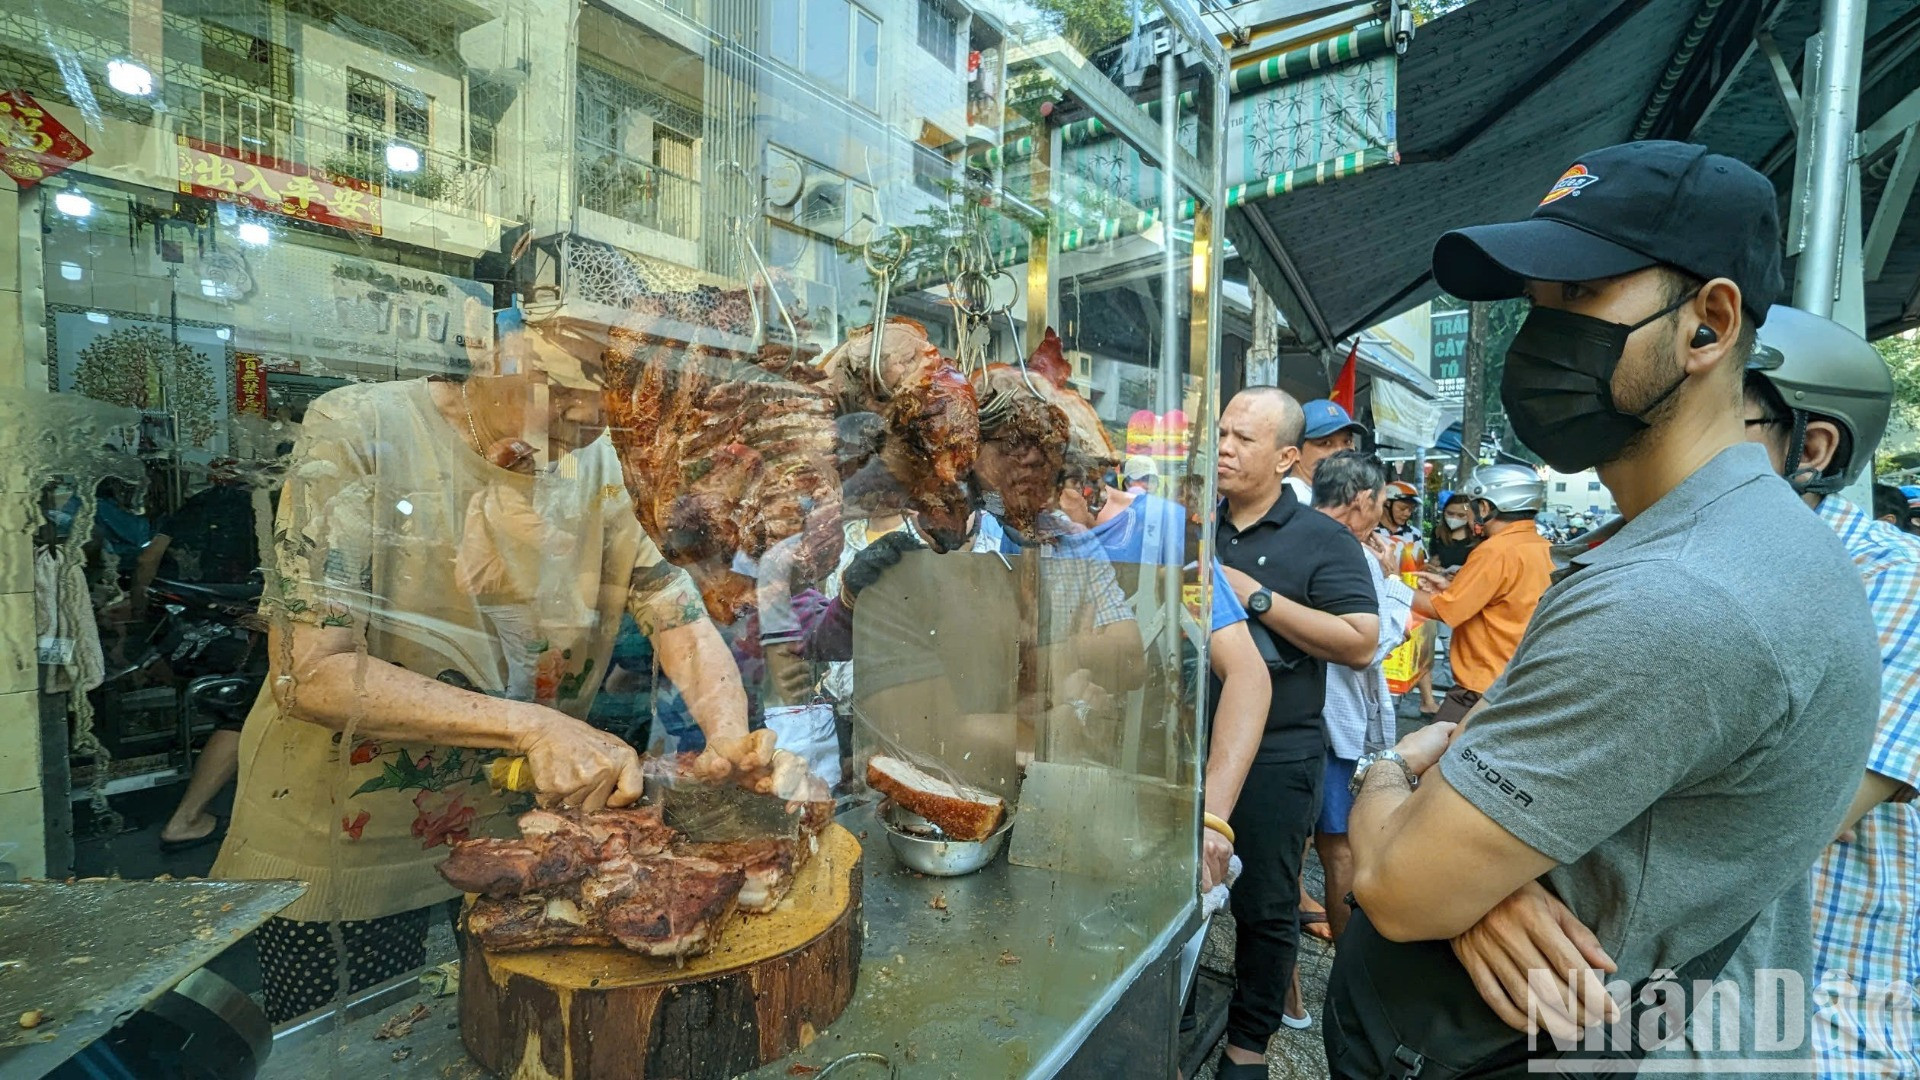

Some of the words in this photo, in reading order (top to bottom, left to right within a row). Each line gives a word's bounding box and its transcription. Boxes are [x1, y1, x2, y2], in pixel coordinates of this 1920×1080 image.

[195, 153, 369, 222] 出入平安
[1434, 338, 1465, 358] CÂY
[1440, 359, 1459, 379] TÔ
[1461, 748, 1533, 808] SPYDER
